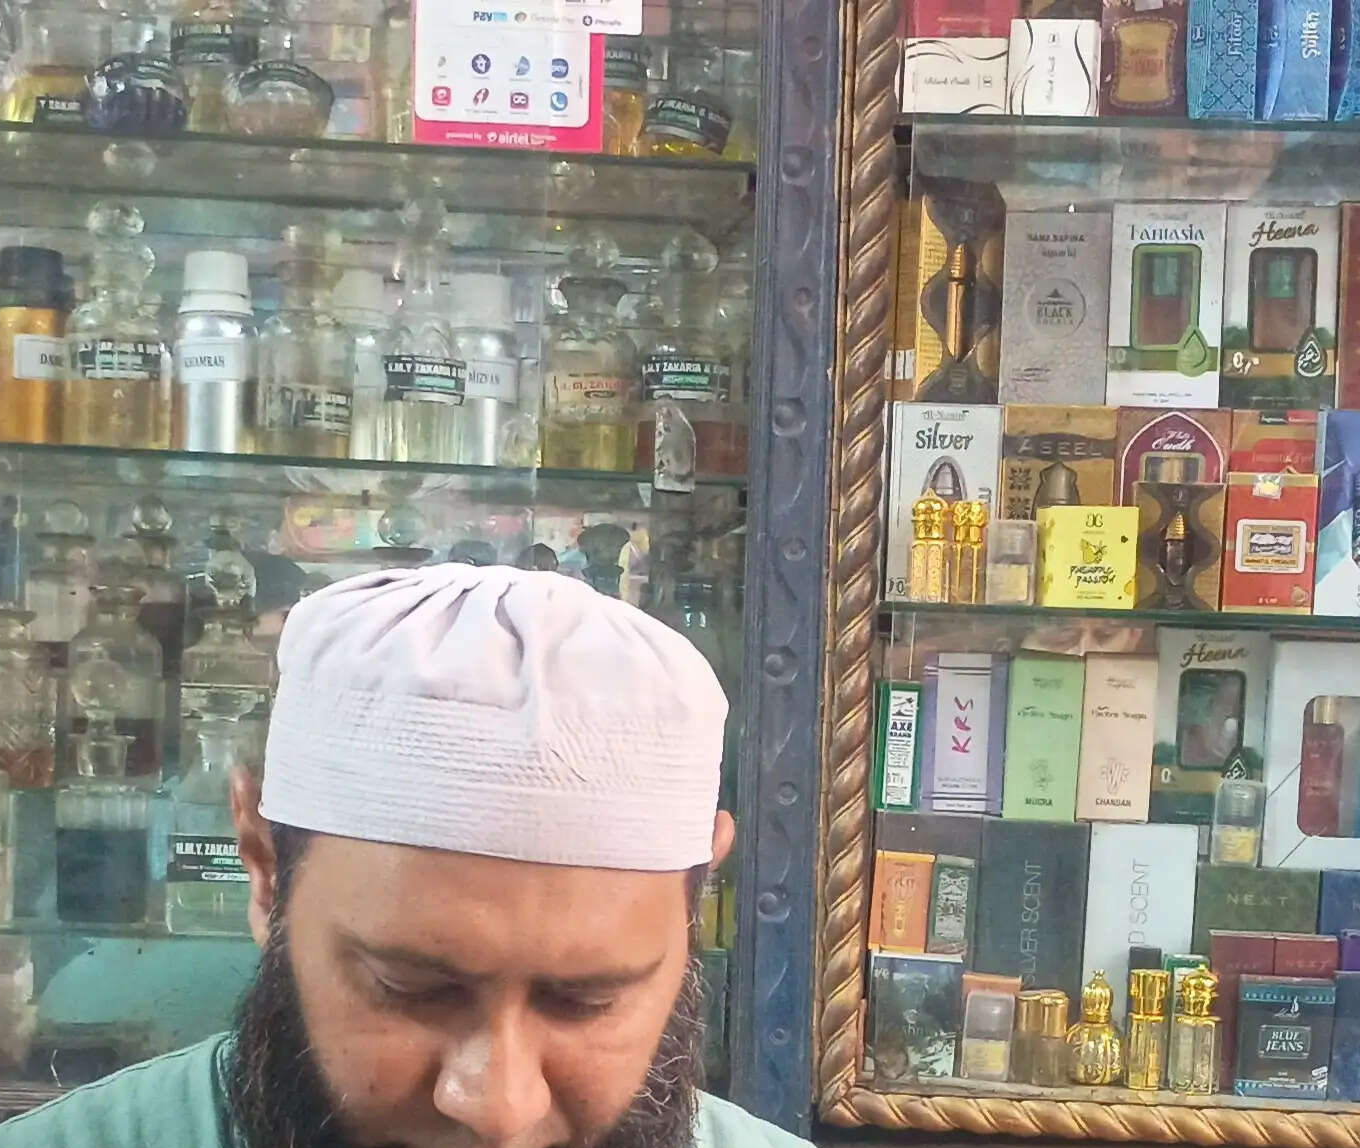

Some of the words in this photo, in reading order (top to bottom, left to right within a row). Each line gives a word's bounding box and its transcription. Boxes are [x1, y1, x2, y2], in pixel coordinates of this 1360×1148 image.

[1248, 221, 1320, 248] Heena
[915, 422, 974, 451] Silver
[1017, 437, 1103, 457] ASEEL
[1179, 643, 1250, 668] Heena
[890, 720, 913, 733] AXE
[951, 695, 975, 755] KRS
[1095, 799, 1132, 808] CHANDAN
[1021, 860, 1042, 923] SCENT
[1128, 858, 1152, 923] SCENT
[1225, 892, 1289, 907] NEXT
[1264, 1040, 1305, 1054] JEANS
[1271, 1030, 1299, 1042] BLUE
